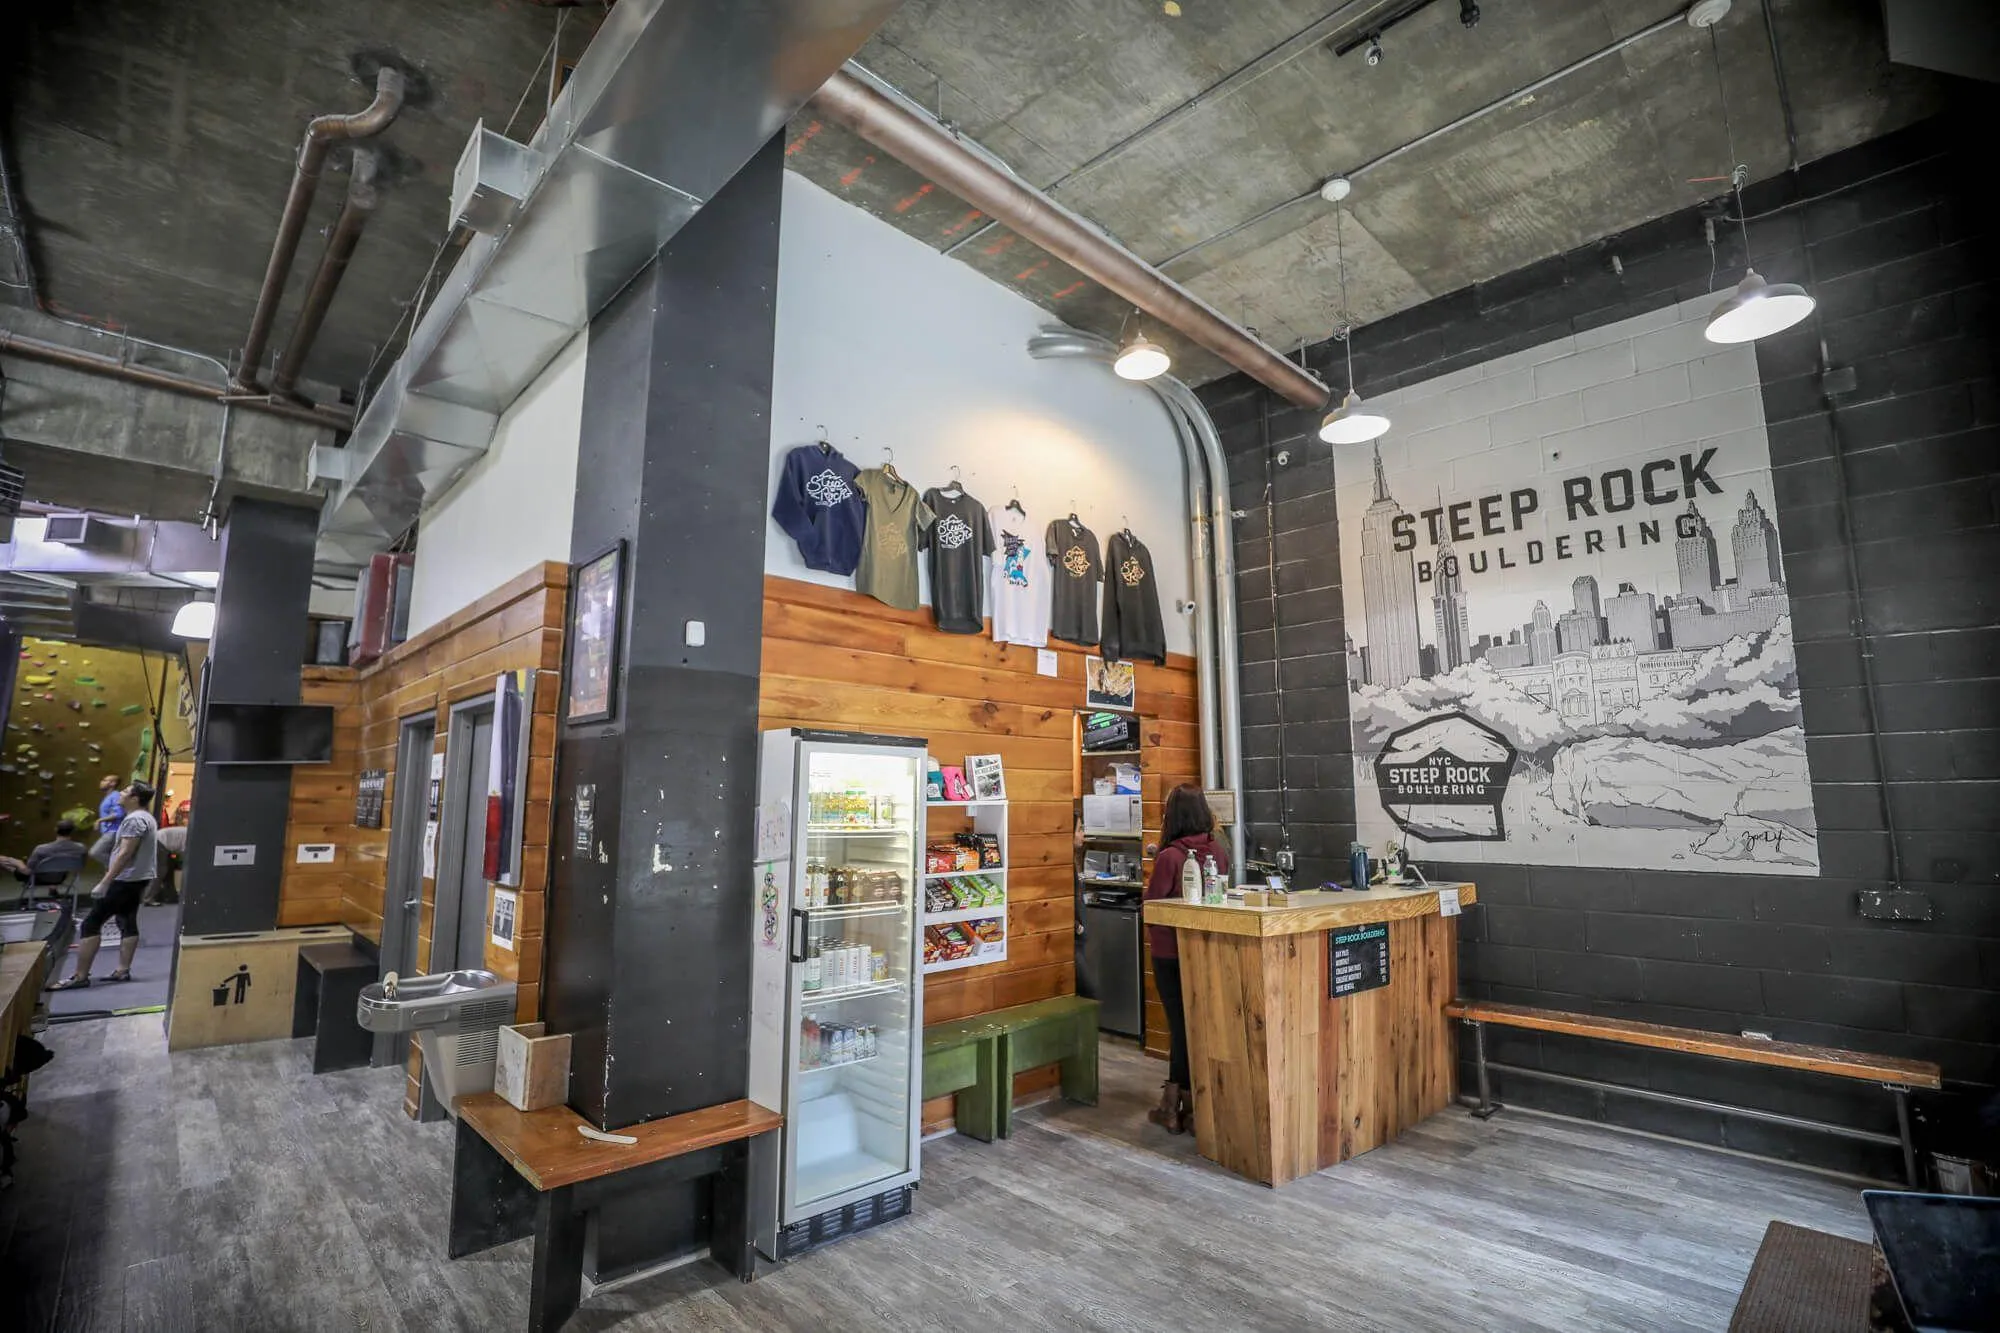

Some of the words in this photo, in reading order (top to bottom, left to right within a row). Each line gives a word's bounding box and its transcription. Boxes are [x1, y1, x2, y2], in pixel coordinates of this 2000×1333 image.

[1391, 488, 1538, 553] STEEP
[1563, 447, 1724, 521] ROCK
[1417, 513, 1697, 583] BOULDERING
[1428, 757, 1452, 766] NYC
[1389, 767, 1440, 784] STEEP
[1446, 766, 1491, 784] ROCK
[1398, 784, 1485, 795] BOULDERING
